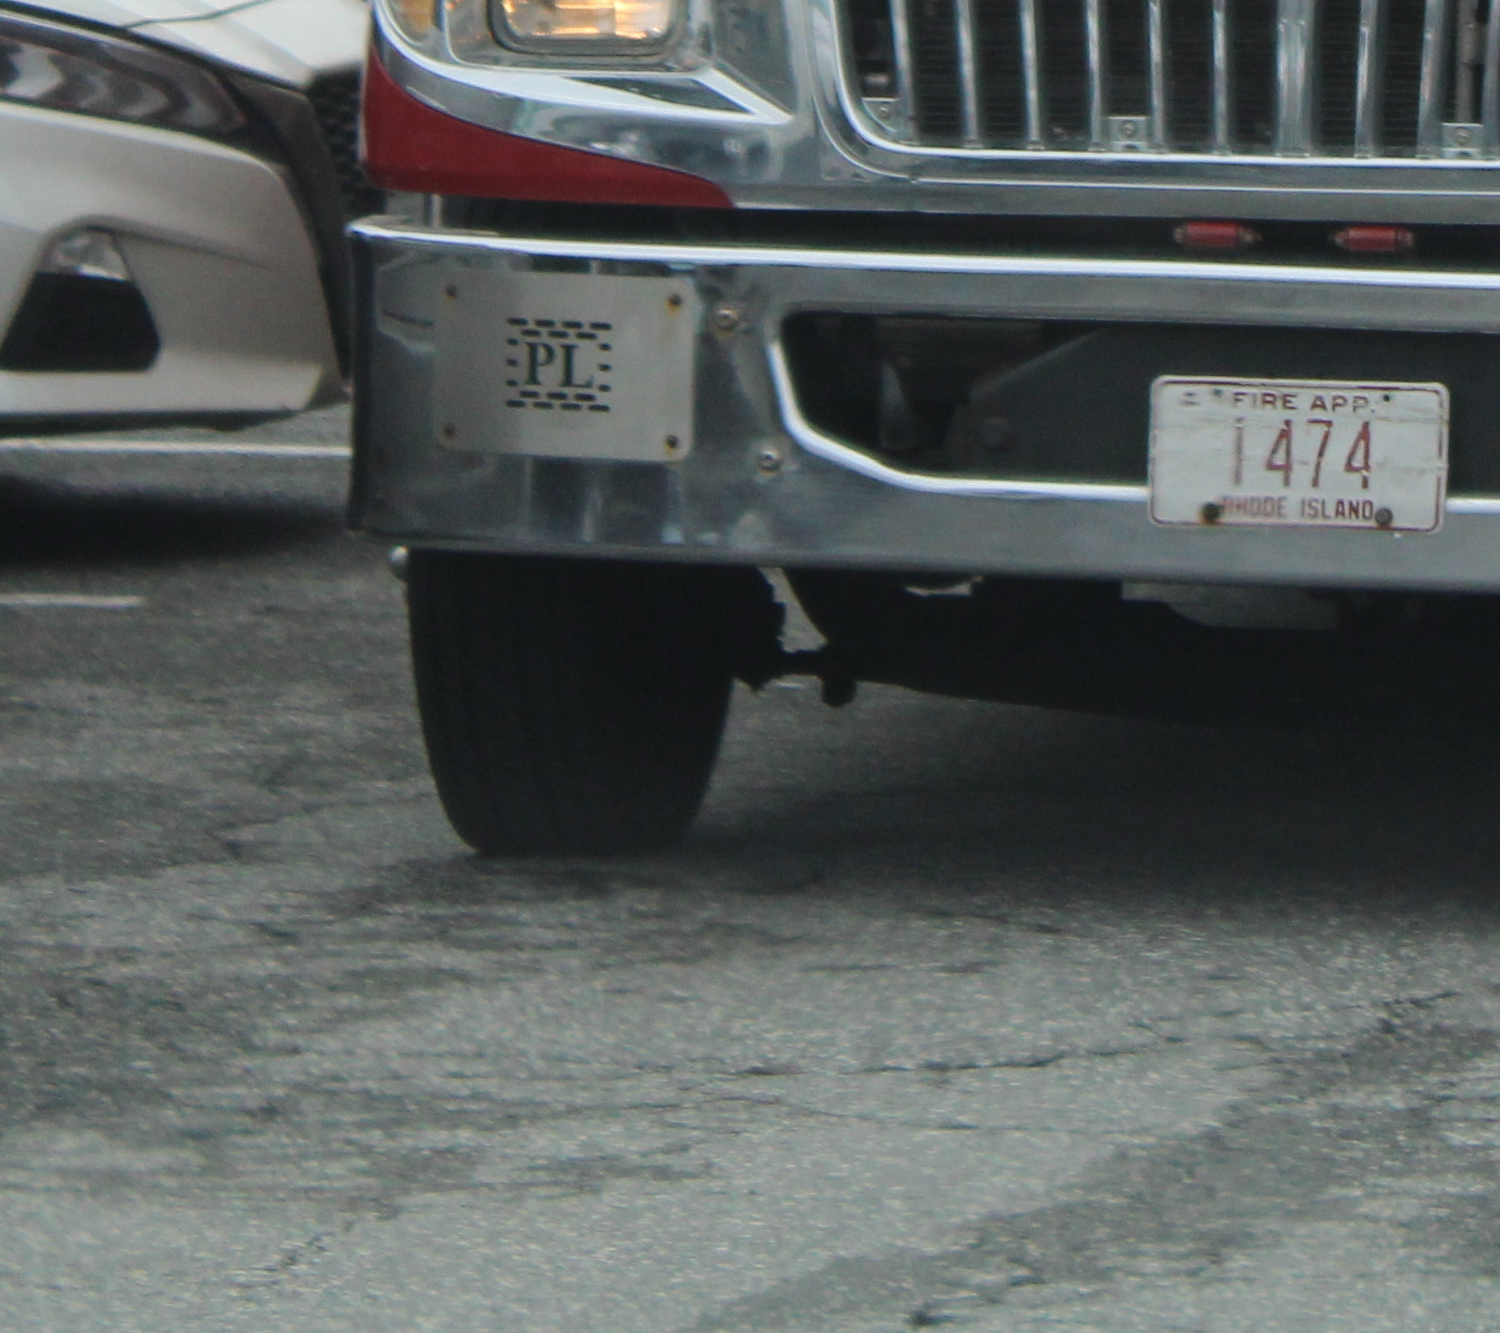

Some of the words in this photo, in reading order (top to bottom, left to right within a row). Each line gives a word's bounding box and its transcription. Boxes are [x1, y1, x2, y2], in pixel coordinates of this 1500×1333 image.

[524, 342, 595, 389] PL
[1233, 391, 1298, 410] FIRE
[1310, 394, 1376, 414] APP.
[1231, 417, 1371, 489] 1474
[1301, 496, 1375, 521] ISLAND
